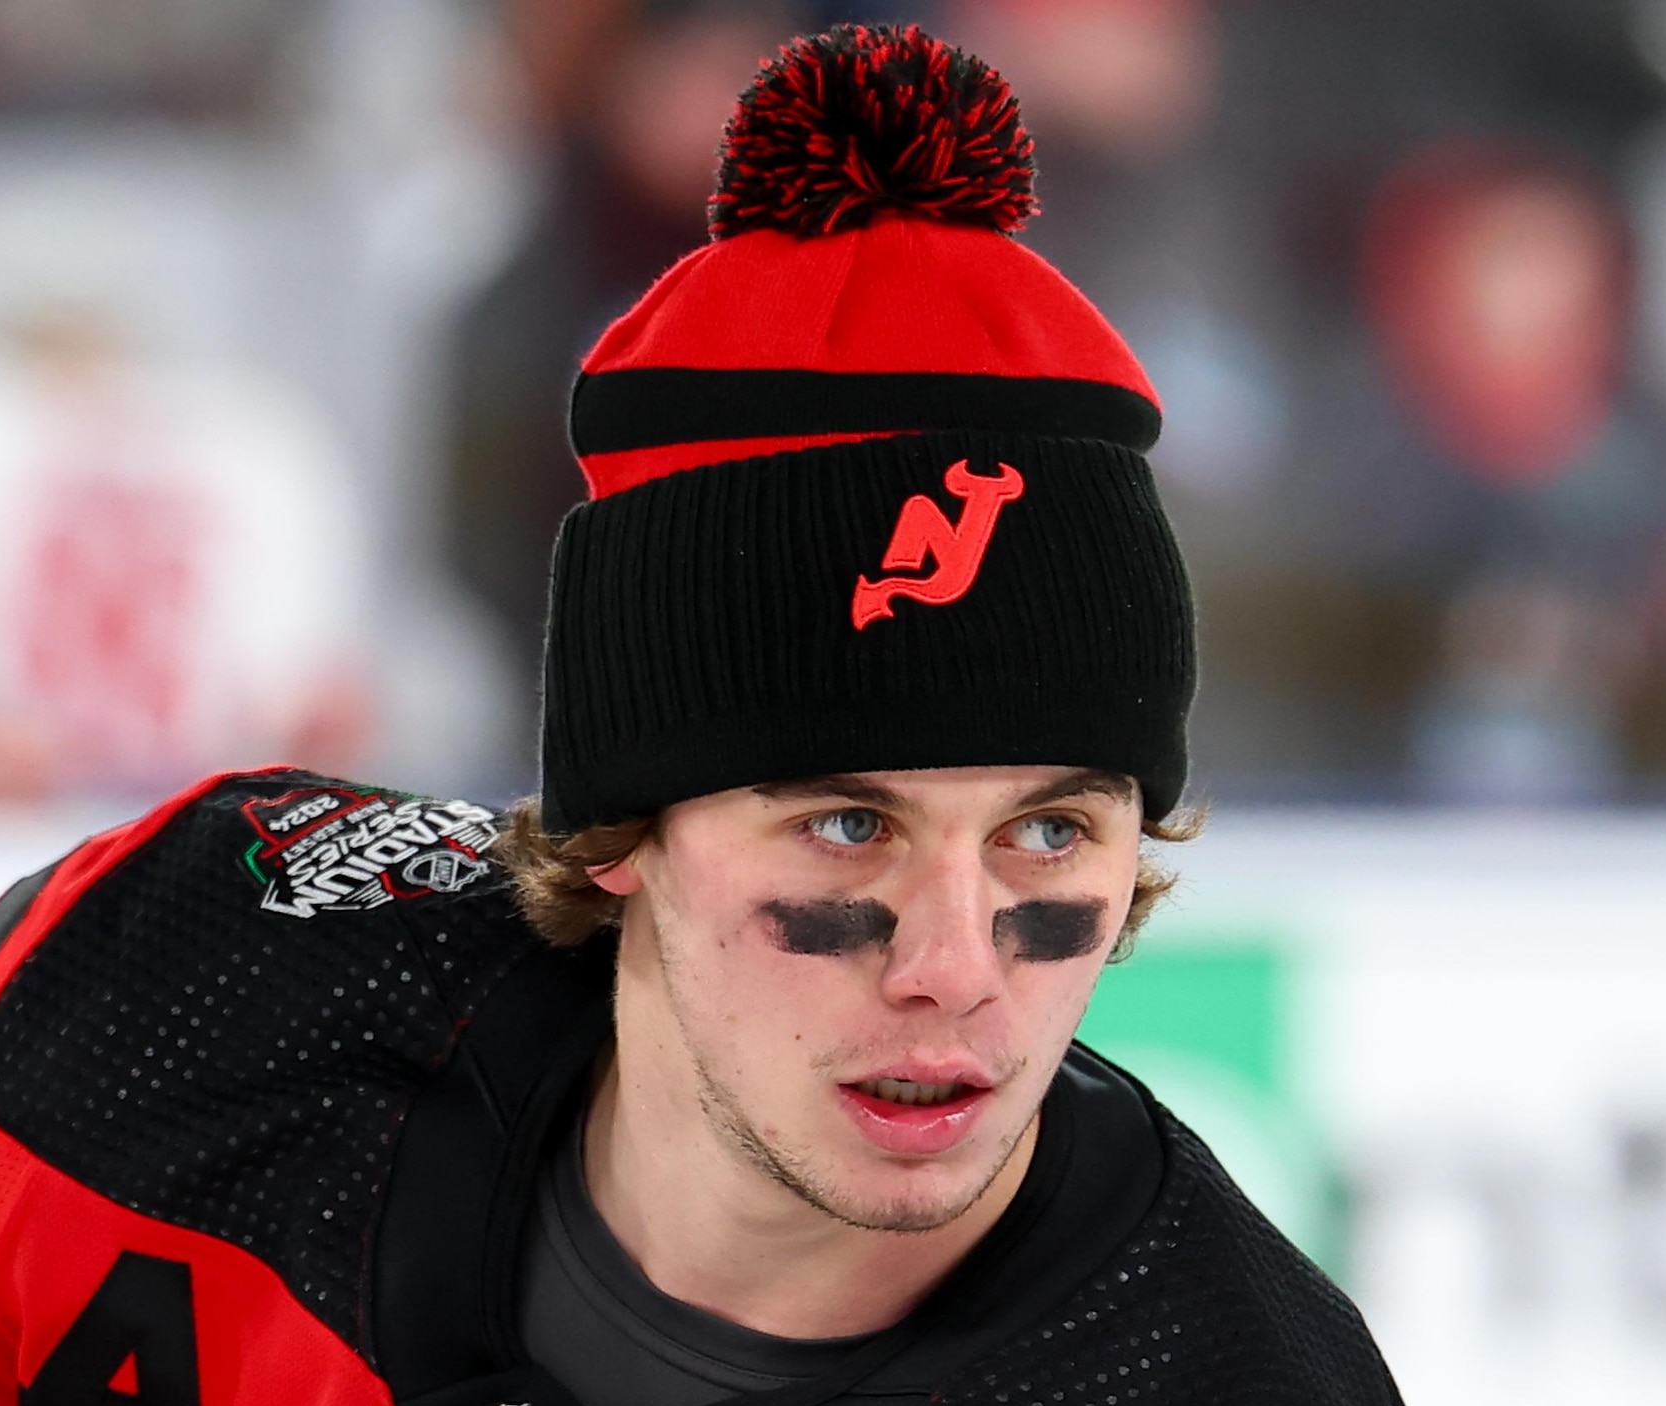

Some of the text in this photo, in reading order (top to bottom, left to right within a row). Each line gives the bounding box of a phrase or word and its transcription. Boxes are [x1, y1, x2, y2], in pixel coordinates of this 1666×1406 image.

[268, 793, 339, 832] 2024
[282, 799, 390, 863] NEW JERSEY
[286, 802, 422, 888] SERIES
[261, 799, 495, 918] STADIUM
